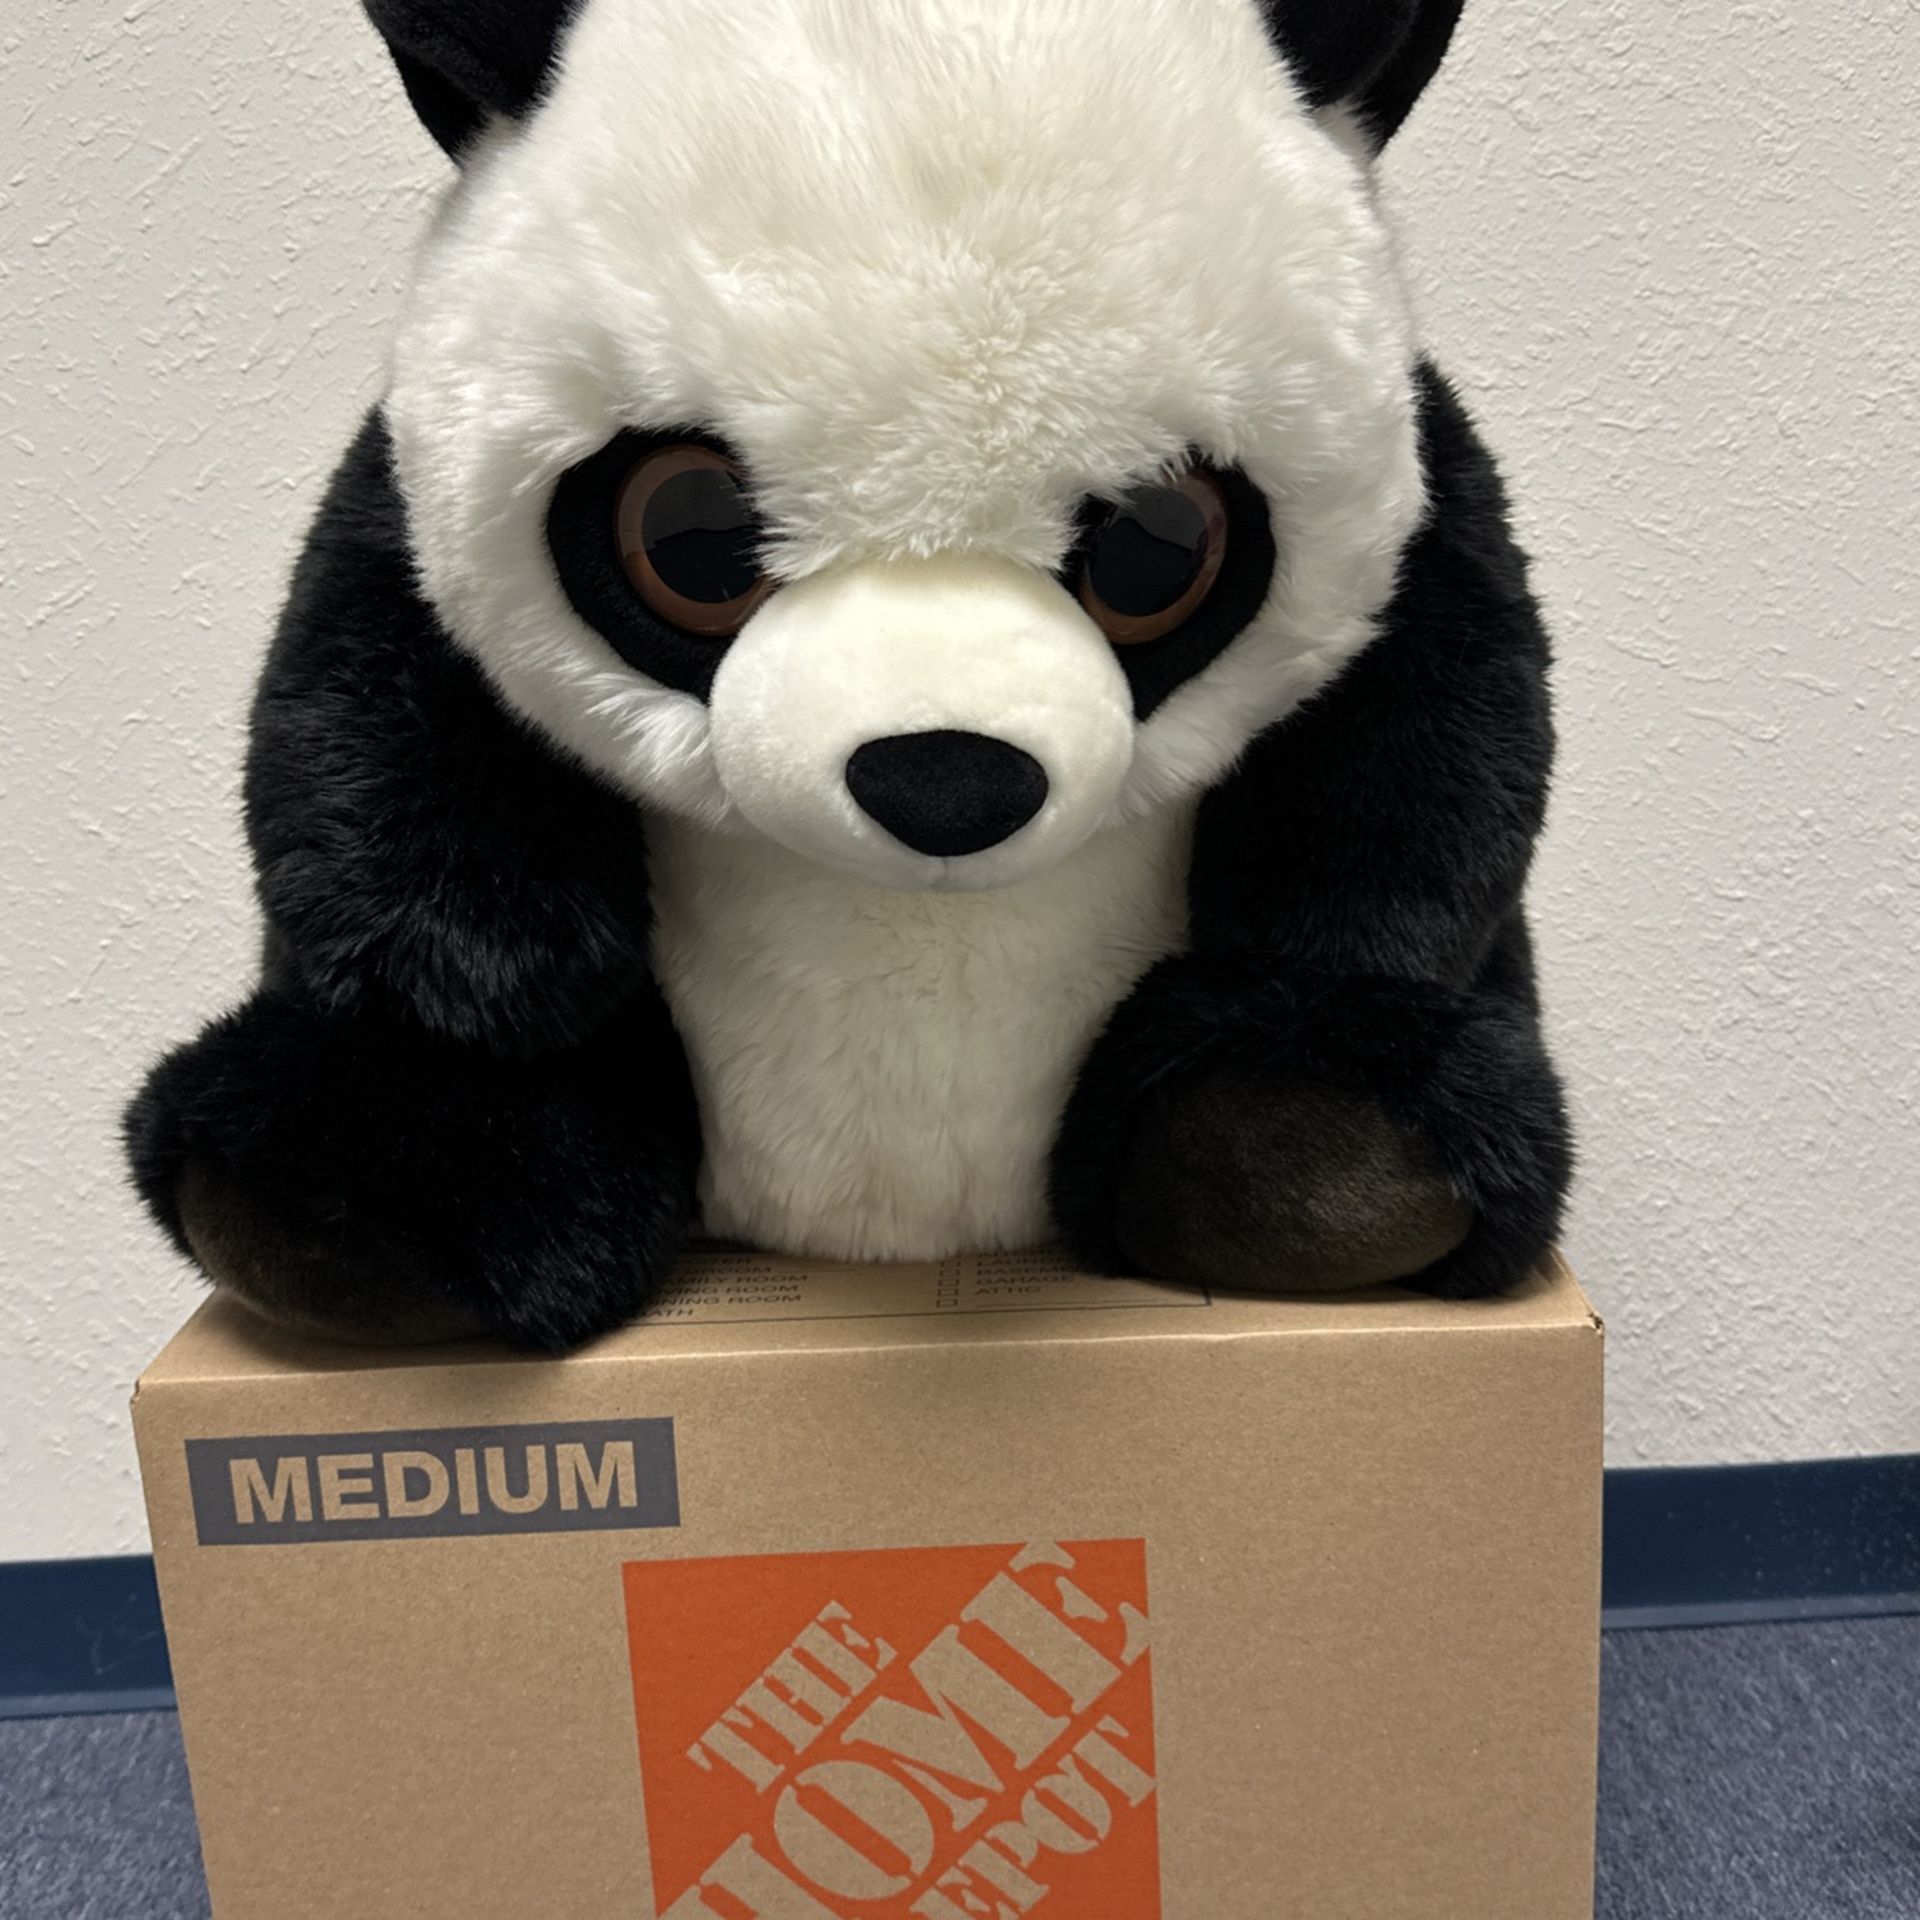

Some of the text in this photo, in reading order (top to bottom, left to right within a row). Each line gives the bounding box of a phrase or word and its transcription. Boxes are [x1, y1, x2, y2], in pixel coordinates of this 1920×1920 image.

[736, 1274, 808, 1284] ROOM
[976, 1275, 1073, 1285] GARAGE
[656, 1284, 799, 1295] IVING ROOM
[974, 1285, 1042, 1295] ATTIC
[727, 1294, 803, 1305] ROOM
[228, 1440, 638, 1525] MEDIUM
[685, 1599, 898, 1795] THE
[906, 1714, 1158, 1920] EPOT
